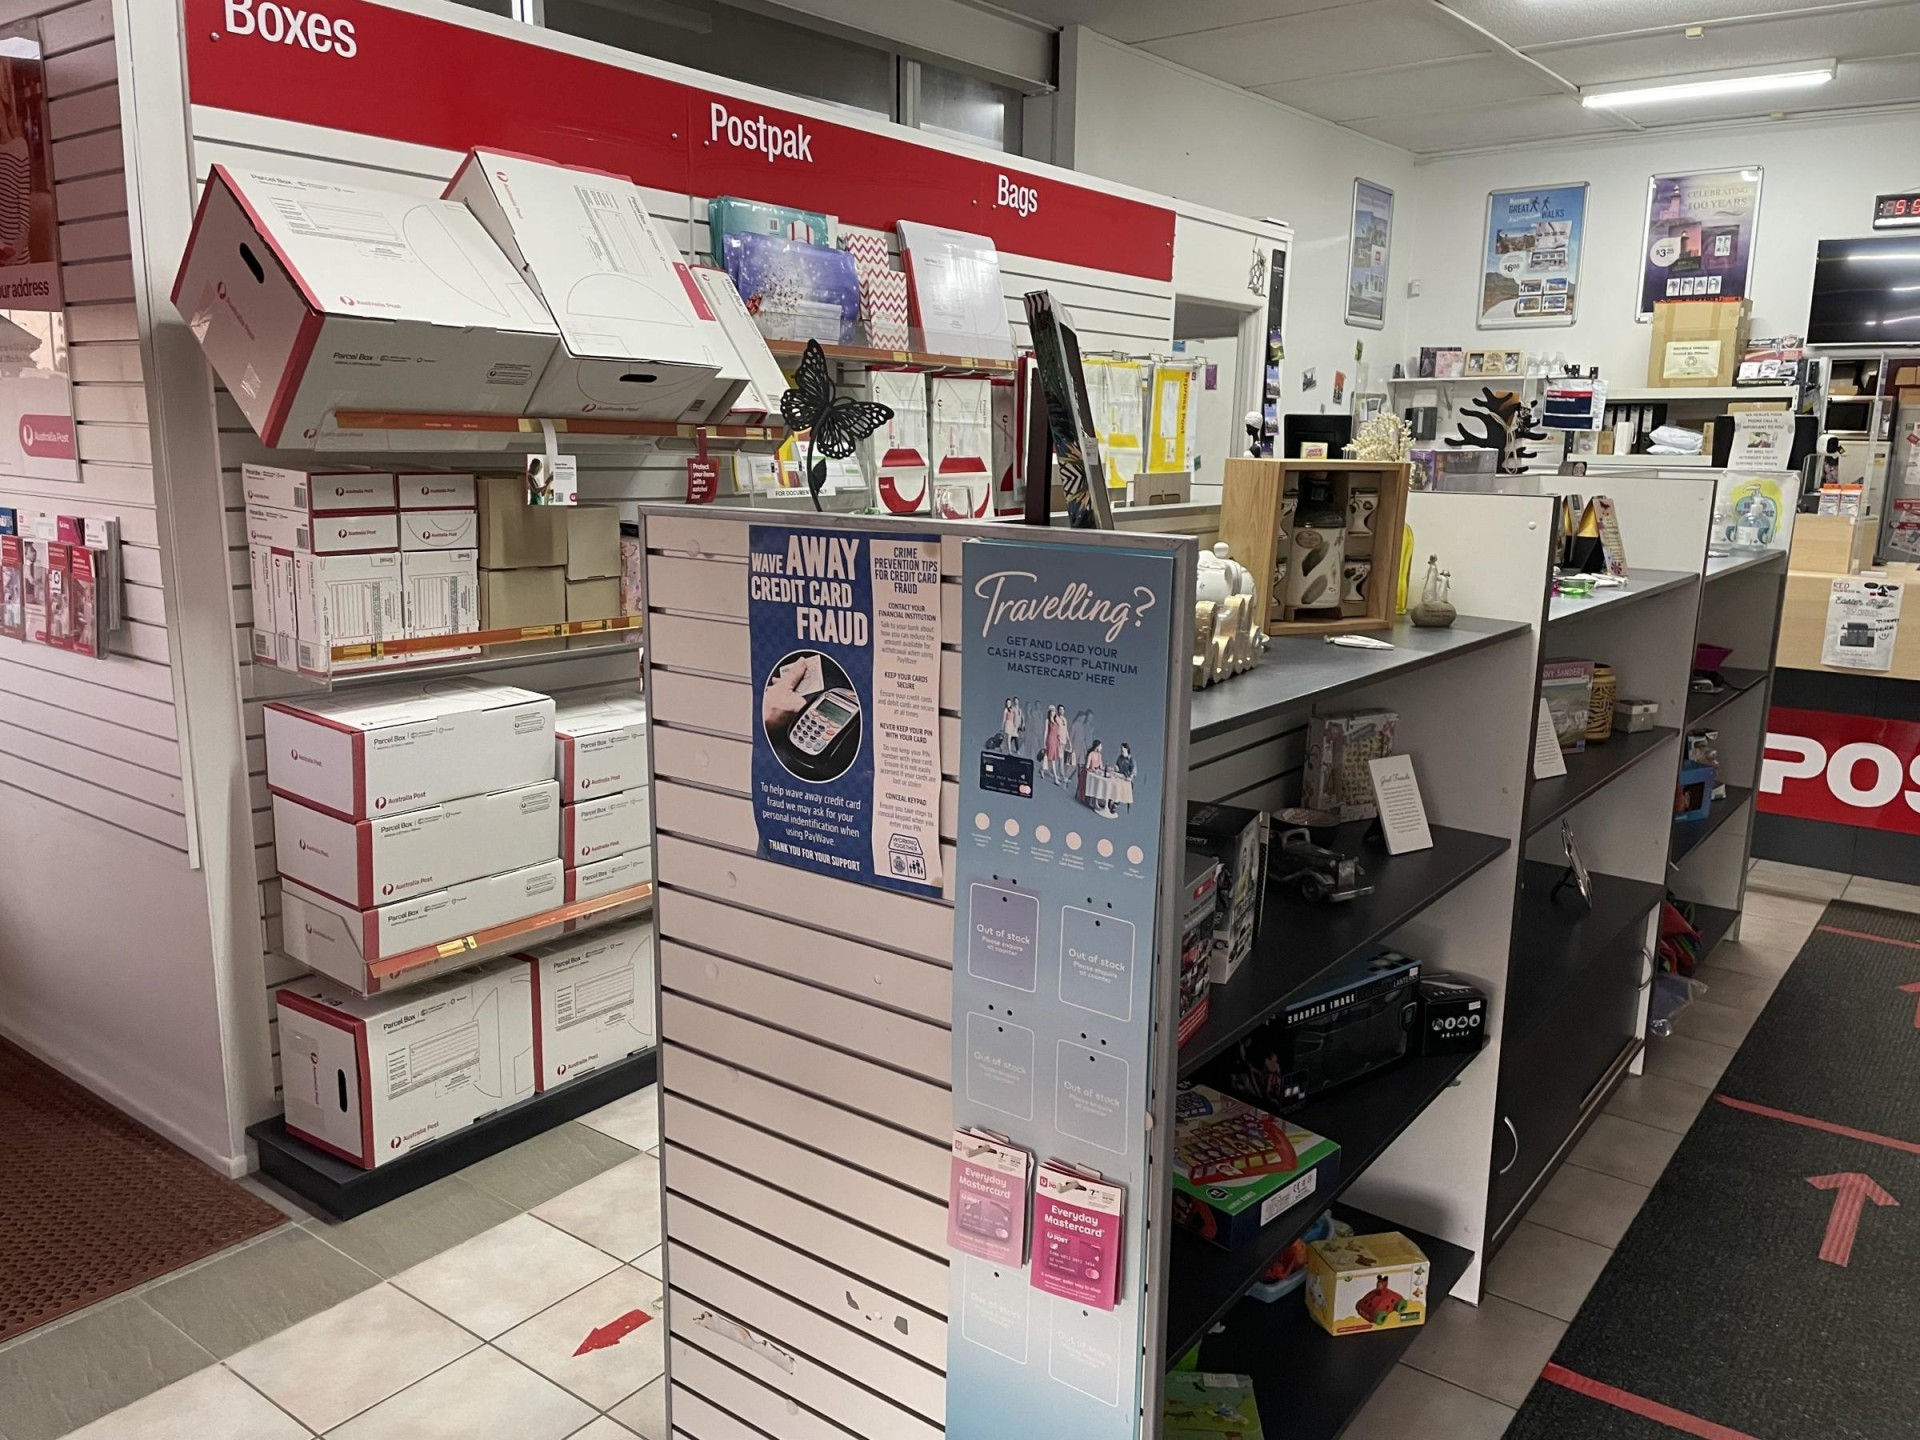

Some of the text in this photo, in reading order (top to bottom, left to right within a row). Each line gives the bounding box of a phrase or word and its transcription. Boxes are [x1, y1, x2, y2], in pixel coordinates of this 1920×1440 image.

[226, 0, 358, 58] Boxes
[710, 102, 813, 163] Postpak
[997, 173, 1038, 217] Bags
[1688, 188, 1748, 199] CELEBRATING
[1509, 204, 1529, 214] GREAT
[1688, 198, 1748, 210] 100 YEARS
[1542, 208, 1565, 219] WALKS
[12, 278, 49, 297] address
[332, 352, 373, 361] Parcel Box
[34, 431, 69, 443] Australia Post
[751, 535, 859, 580] WAVE AWAY
[894, 547, 918, 559] CRIME
[874, 558, 938, 572] PREVENTION TIPS
[875, 570, 937, 584] FOR CREDIT CARD
[751, 576, 852, 607] CREDIT CARD
[895, 583, 918, 594] FRAUD
[888, 602, 909, 611] CONTACT
[974, 571, 1156, 644] Travelling?
[1835, 596, 1863, 606] Easter
[879, 610, 936, 621] FINANCIAL INSTITUTION
[796, 607, 868, 646] FRAUD
[1007, 636, 1117, 658] GET AND LOAD YOUR
[988, 646, 1016, 658] CASH
[1082, 658, 1138, 675] PLATINUM
[1557, 668, 1585, 677] SANDERS
[1086, 674, 1115, 686] HERE
[880, 722, 895, 730] NEVER
[374, 734, 406, 746] Parcel Box
[581, 741, 596, 750] Parcel
[1759, 732, 1920, 814] PO
[591, 776, 610, 785] Australia
[388, 791, 426, 804] Australia Post
[761, 782, 861, 810] To help wave away credit card
[886, 792, 927, 806] CONCEAL KEYPAD
[767, 796, 854, 823] fraud we may ask for your
[380, 823, 400, 833] Parcel
[763, 809, 859, 838] personal indentification when
[786, 828, 803, 840] using
[892, 836, 918, 846] WORKING
[893, 841, 918, 851] TOGETHER
[769, 839, 860, 871] THANK YOU FOR YOUR SUPPORT
[395, 876, 433, 890] Australia Post
[582, 873, 597, 882] Parcel
[388, 909, 419, 923] Parcel Box
[977, 923, 1031, 945] Out of stock
[553, 955, 582, 970] Parcel Box
[1068, 948, 1125, 972] Out of stock
[1288, 993, 1355, 1024] SHARPER IMAGE
[383, 1013, 416, 1032] Parcel Box
[567, 1053, 599, 1071] Australia Post
[974, 1051, 1026, 1074] Out of stock
[1064, 1080, 1120, 1107] Out of stock
[402, 1120, 440, 1142] Australia Post
[965, 1167, 1007, 1190] Everyday
[1051, 1204, 1099, 1226] Everyday
[1053, 1232, 1069, 1245] POST
